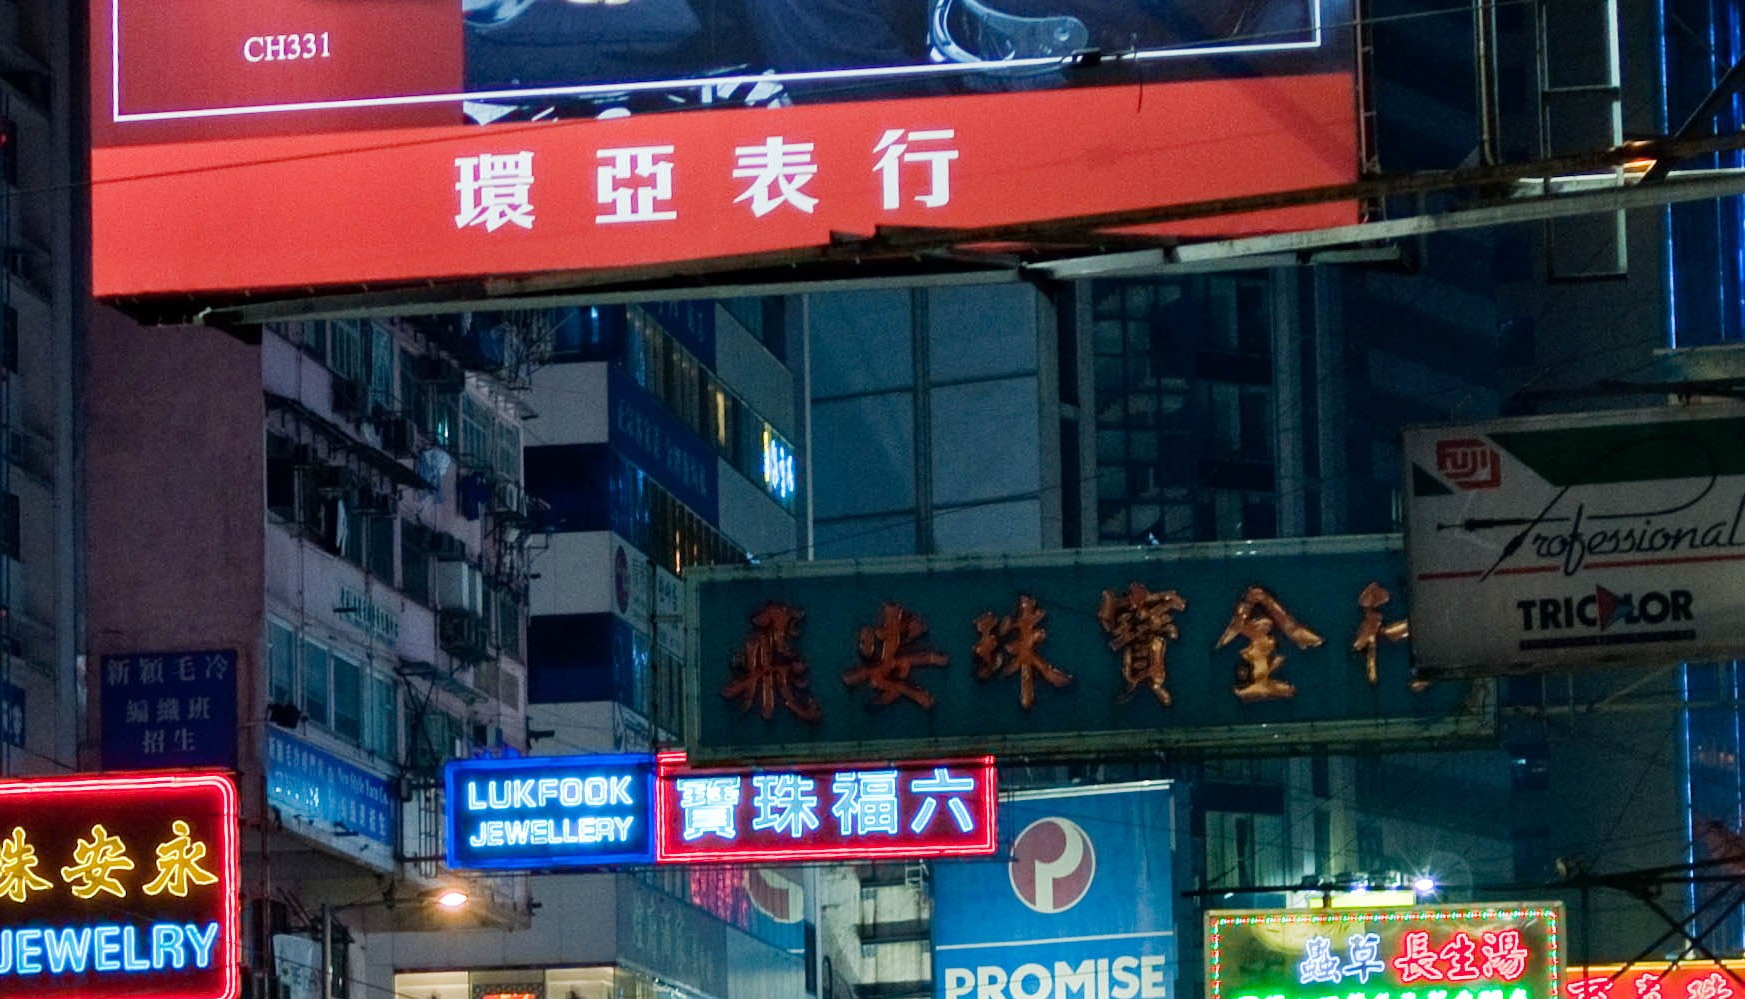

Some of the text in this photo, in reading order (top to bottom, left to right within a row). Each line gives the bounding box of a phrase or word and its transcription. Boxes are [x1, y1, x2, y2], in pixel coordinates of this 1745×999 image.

[243, 33, 332, 60] CH331
[455, 127, 959, 234] 環亞表行
[143, 727, 197, 755] 招生
[468, 776, 632, 809] LUKFOOK
[470, 817, 632, 846] JEWELLERY
[1394, 931, 1528, 984] 長生湯
